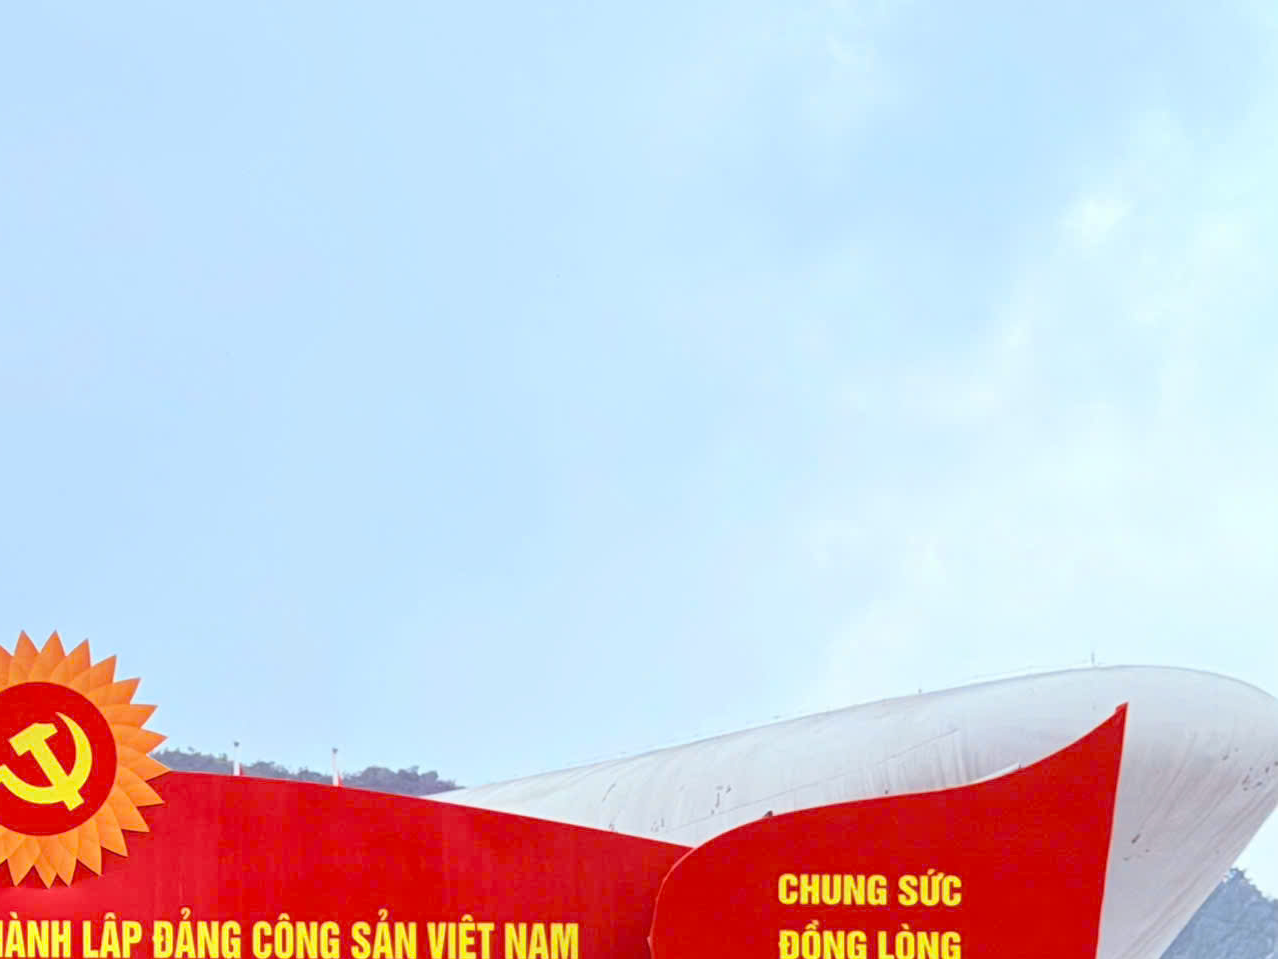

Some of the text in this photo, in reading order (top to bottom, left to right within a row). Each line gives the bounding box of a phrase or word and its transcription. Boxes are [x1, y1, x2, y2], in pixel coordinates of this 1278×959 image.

[778, 868, 962, 907] CHUNG SỨC
[151, 907, 242, 959] ĐẢNG
